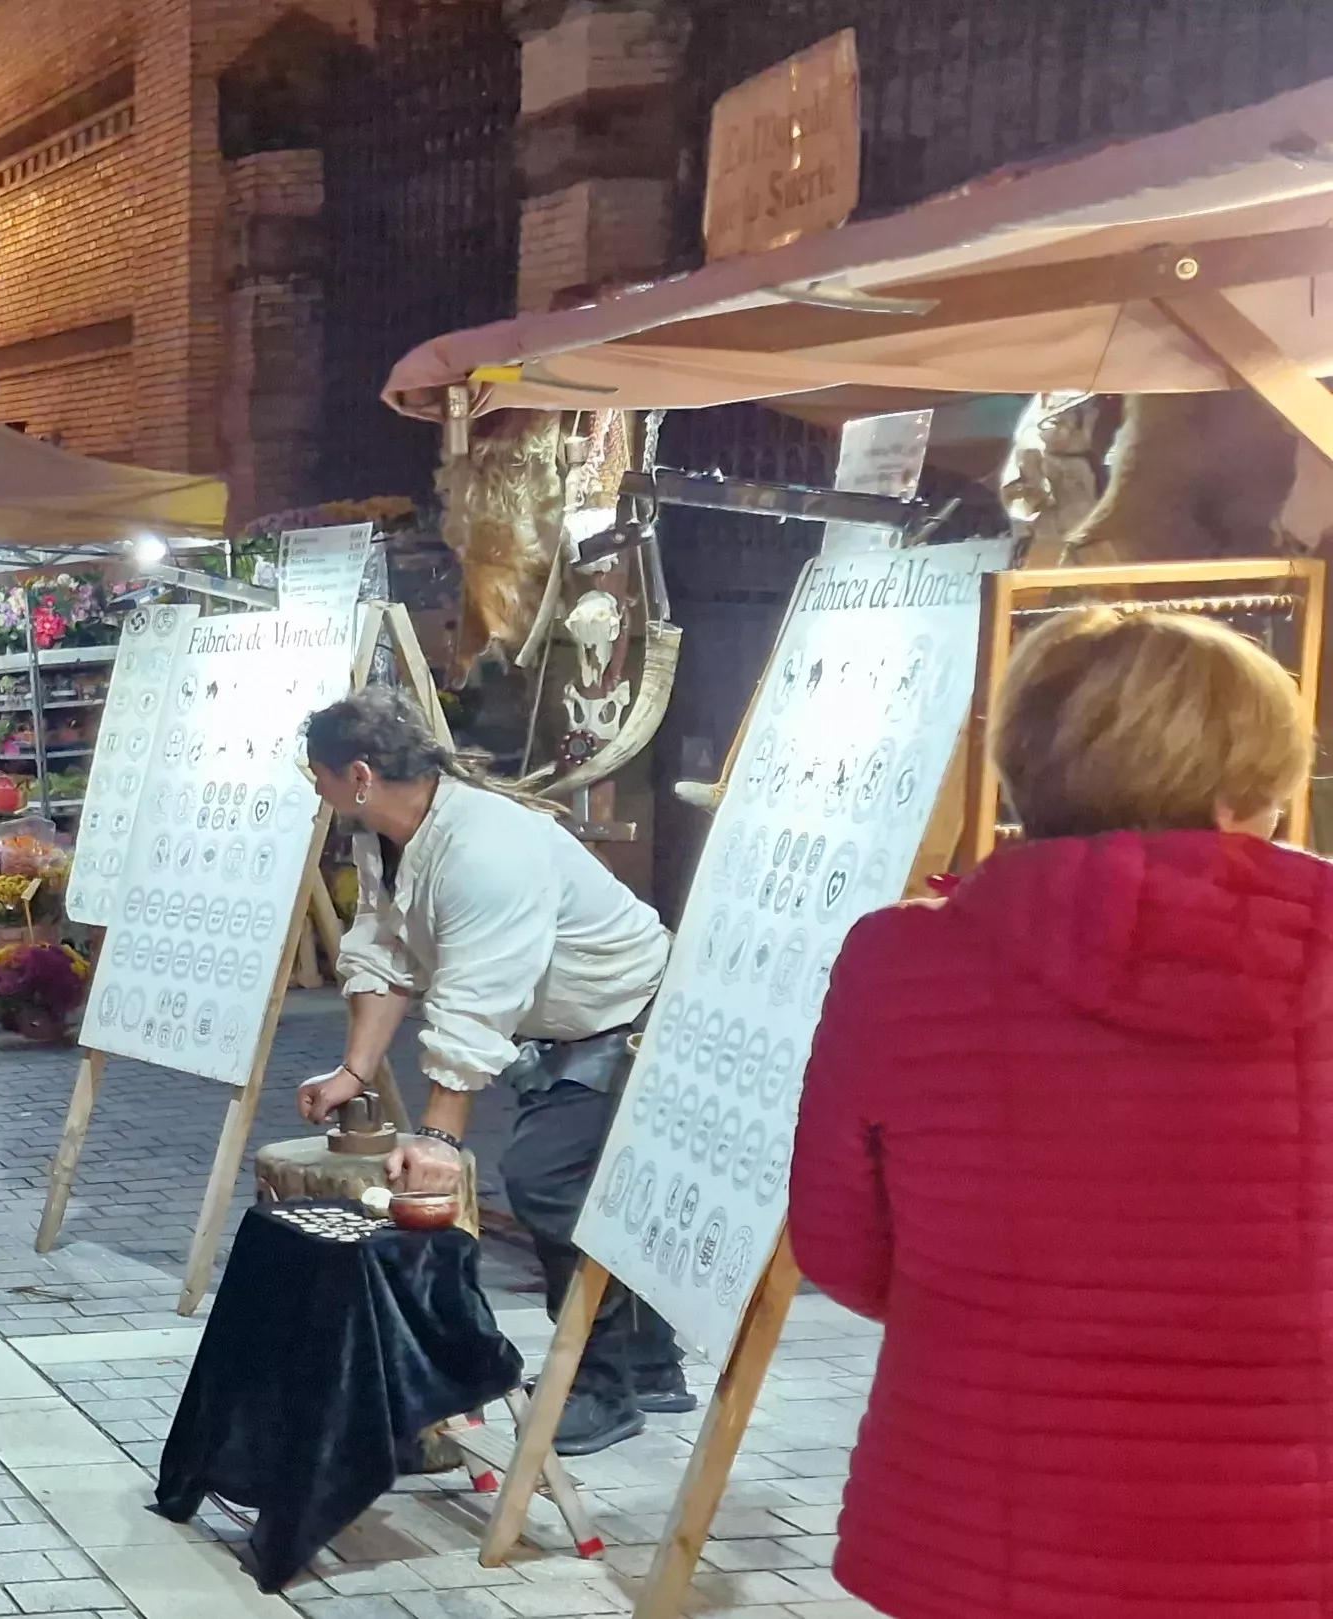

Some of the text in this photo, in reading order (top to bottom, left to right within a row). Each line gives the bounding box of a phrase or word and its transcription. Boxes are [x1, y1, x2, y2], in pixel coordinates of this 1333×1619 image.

[869, 559, 897, 609] de
[894, 553, 981, 607] Moned
[186, 624, 242, 655] Fábrica
[246, 622, 266, 650] de
